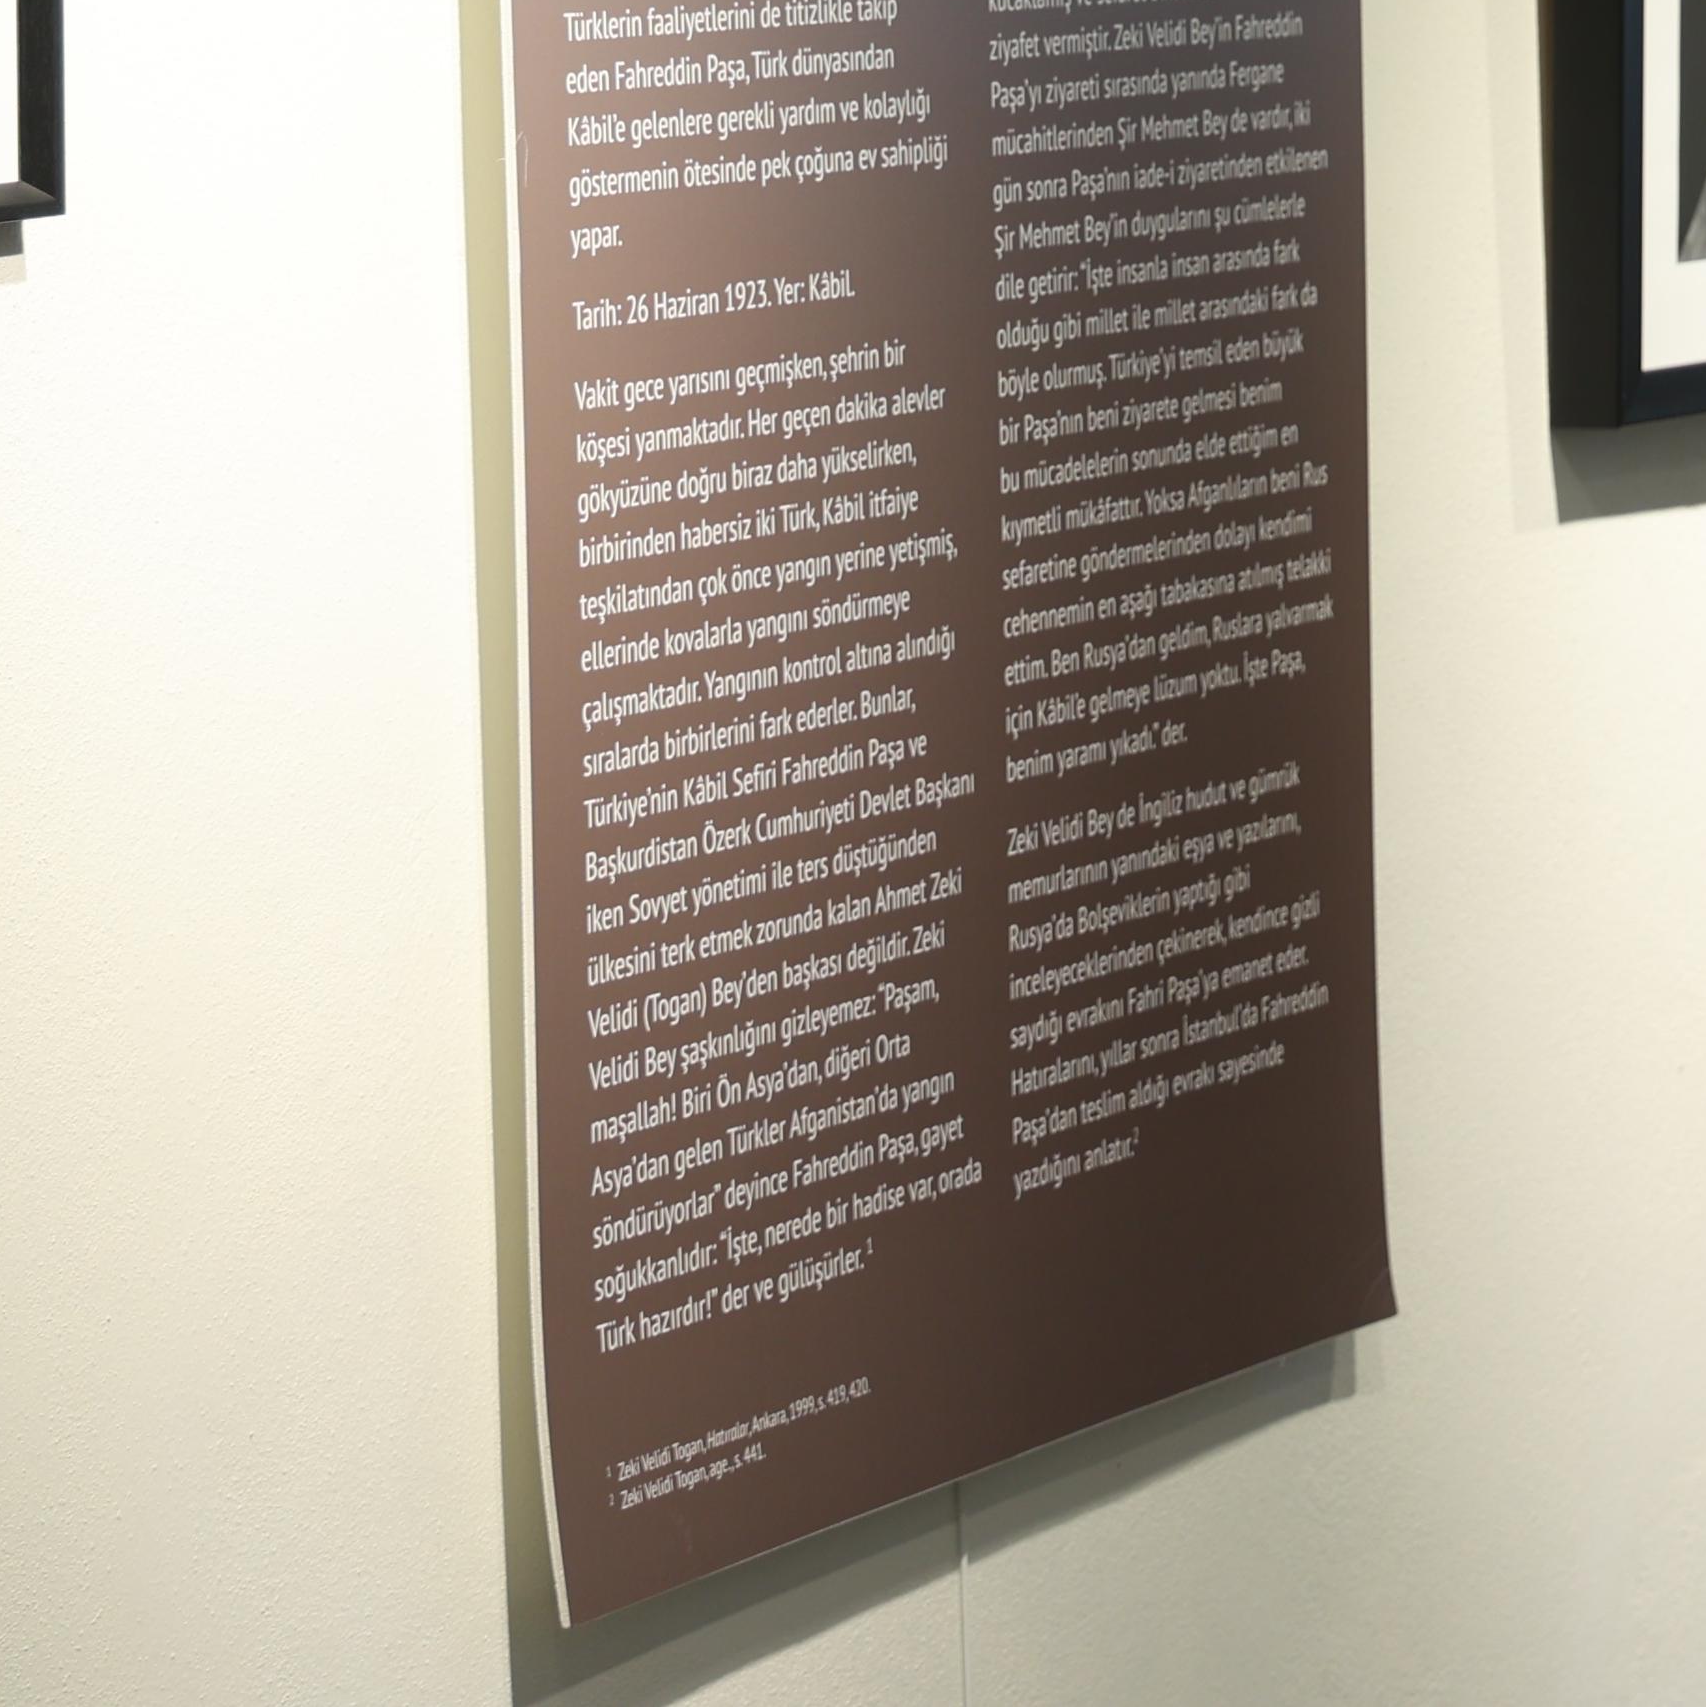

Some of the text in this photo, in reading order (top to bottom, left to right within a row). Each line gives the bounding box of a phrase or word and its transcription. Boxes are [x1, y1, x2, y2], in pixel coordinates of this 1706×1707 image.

[564, 8, 642, 41] Türklerin
[647, 0, 755, 41] faaliyetlerini
[759, 0, 781, 28] de
[565, 42, 894, 94] eden Fahreddin Paşa, Türk dünyasından
[630, 108, 712, 149] gelenlere
[716, 100, 774, 141] gerekli
[778, 97, 835, 135] yardım
[839, 100, 859, 122] ve
[863, 87, 930, 124] kolaylığı
[569, 134, 947, 207] göstermenin ötesinde pek çoğuna ev sahipliği
[570, 224, 622, 259] yapar.
[573, 269, 855, 330] Tarih: 26 Haziran 1923. Yer: Kâbil.
[574, 338, 905, 412] Vakit gece yarısını geçmişken, şehrin bir
[576, 383, 945, 468] köşesi yanmaktadır. Her geçen dakika alevler
[577, 438, 917, 523] gökyüzüne doğru biraz daha yükselirken,
[578, 486, 918, 568] birbirinden habersiz iki Türk, Kâbil itfaiye
[579, 527, 958, 625] teşkilatından çok önce yangın yerine yetişmiş,
[673, 1137, 723, 1180] gelen
[726, 1117, 786, 1156] Türkler
[901, 1071, 954, 1113] yangın
[724, 1170, 788, 1211] deyince
[792, 1140, 874, 1188] Fahreddin
[877, 1132, 919, 1164] Paşa,
[920, 1115, 963, 1157] gayet
[594, 1241, 717, 1303] soğukkanlıdır:
[764, 1206, 821, 1248] nerede
[825, 1197, 848, 1229] bir
[852, 1183, 905, 1220] hadise
[908, 1175, 937, 1202] var,
[938, 1156, 982, 1194] orada
[595, 1315, 636, 1353] Türk
[721, 1282, 749, 1314] der
[753, 1277, 773, 1302] ve
[776, 1247, 865, 1303] gülüşürler.
[617, 1456, 641, 1482] Zeki
[641, 1445, 672, 1473] Velidi
[672, 1441, 707, 1462] Togan,
[752, 1409, 790, 1434] Ankara,
[789, 1395, 819, 1421] 1999,
[620, 1484, 644, 1510] Zeki
[644, 1474, 675, 1500] Velidi
[674, 1469, 710, 1491] Togan,
[744, 1441, 767, 1464] 441.
